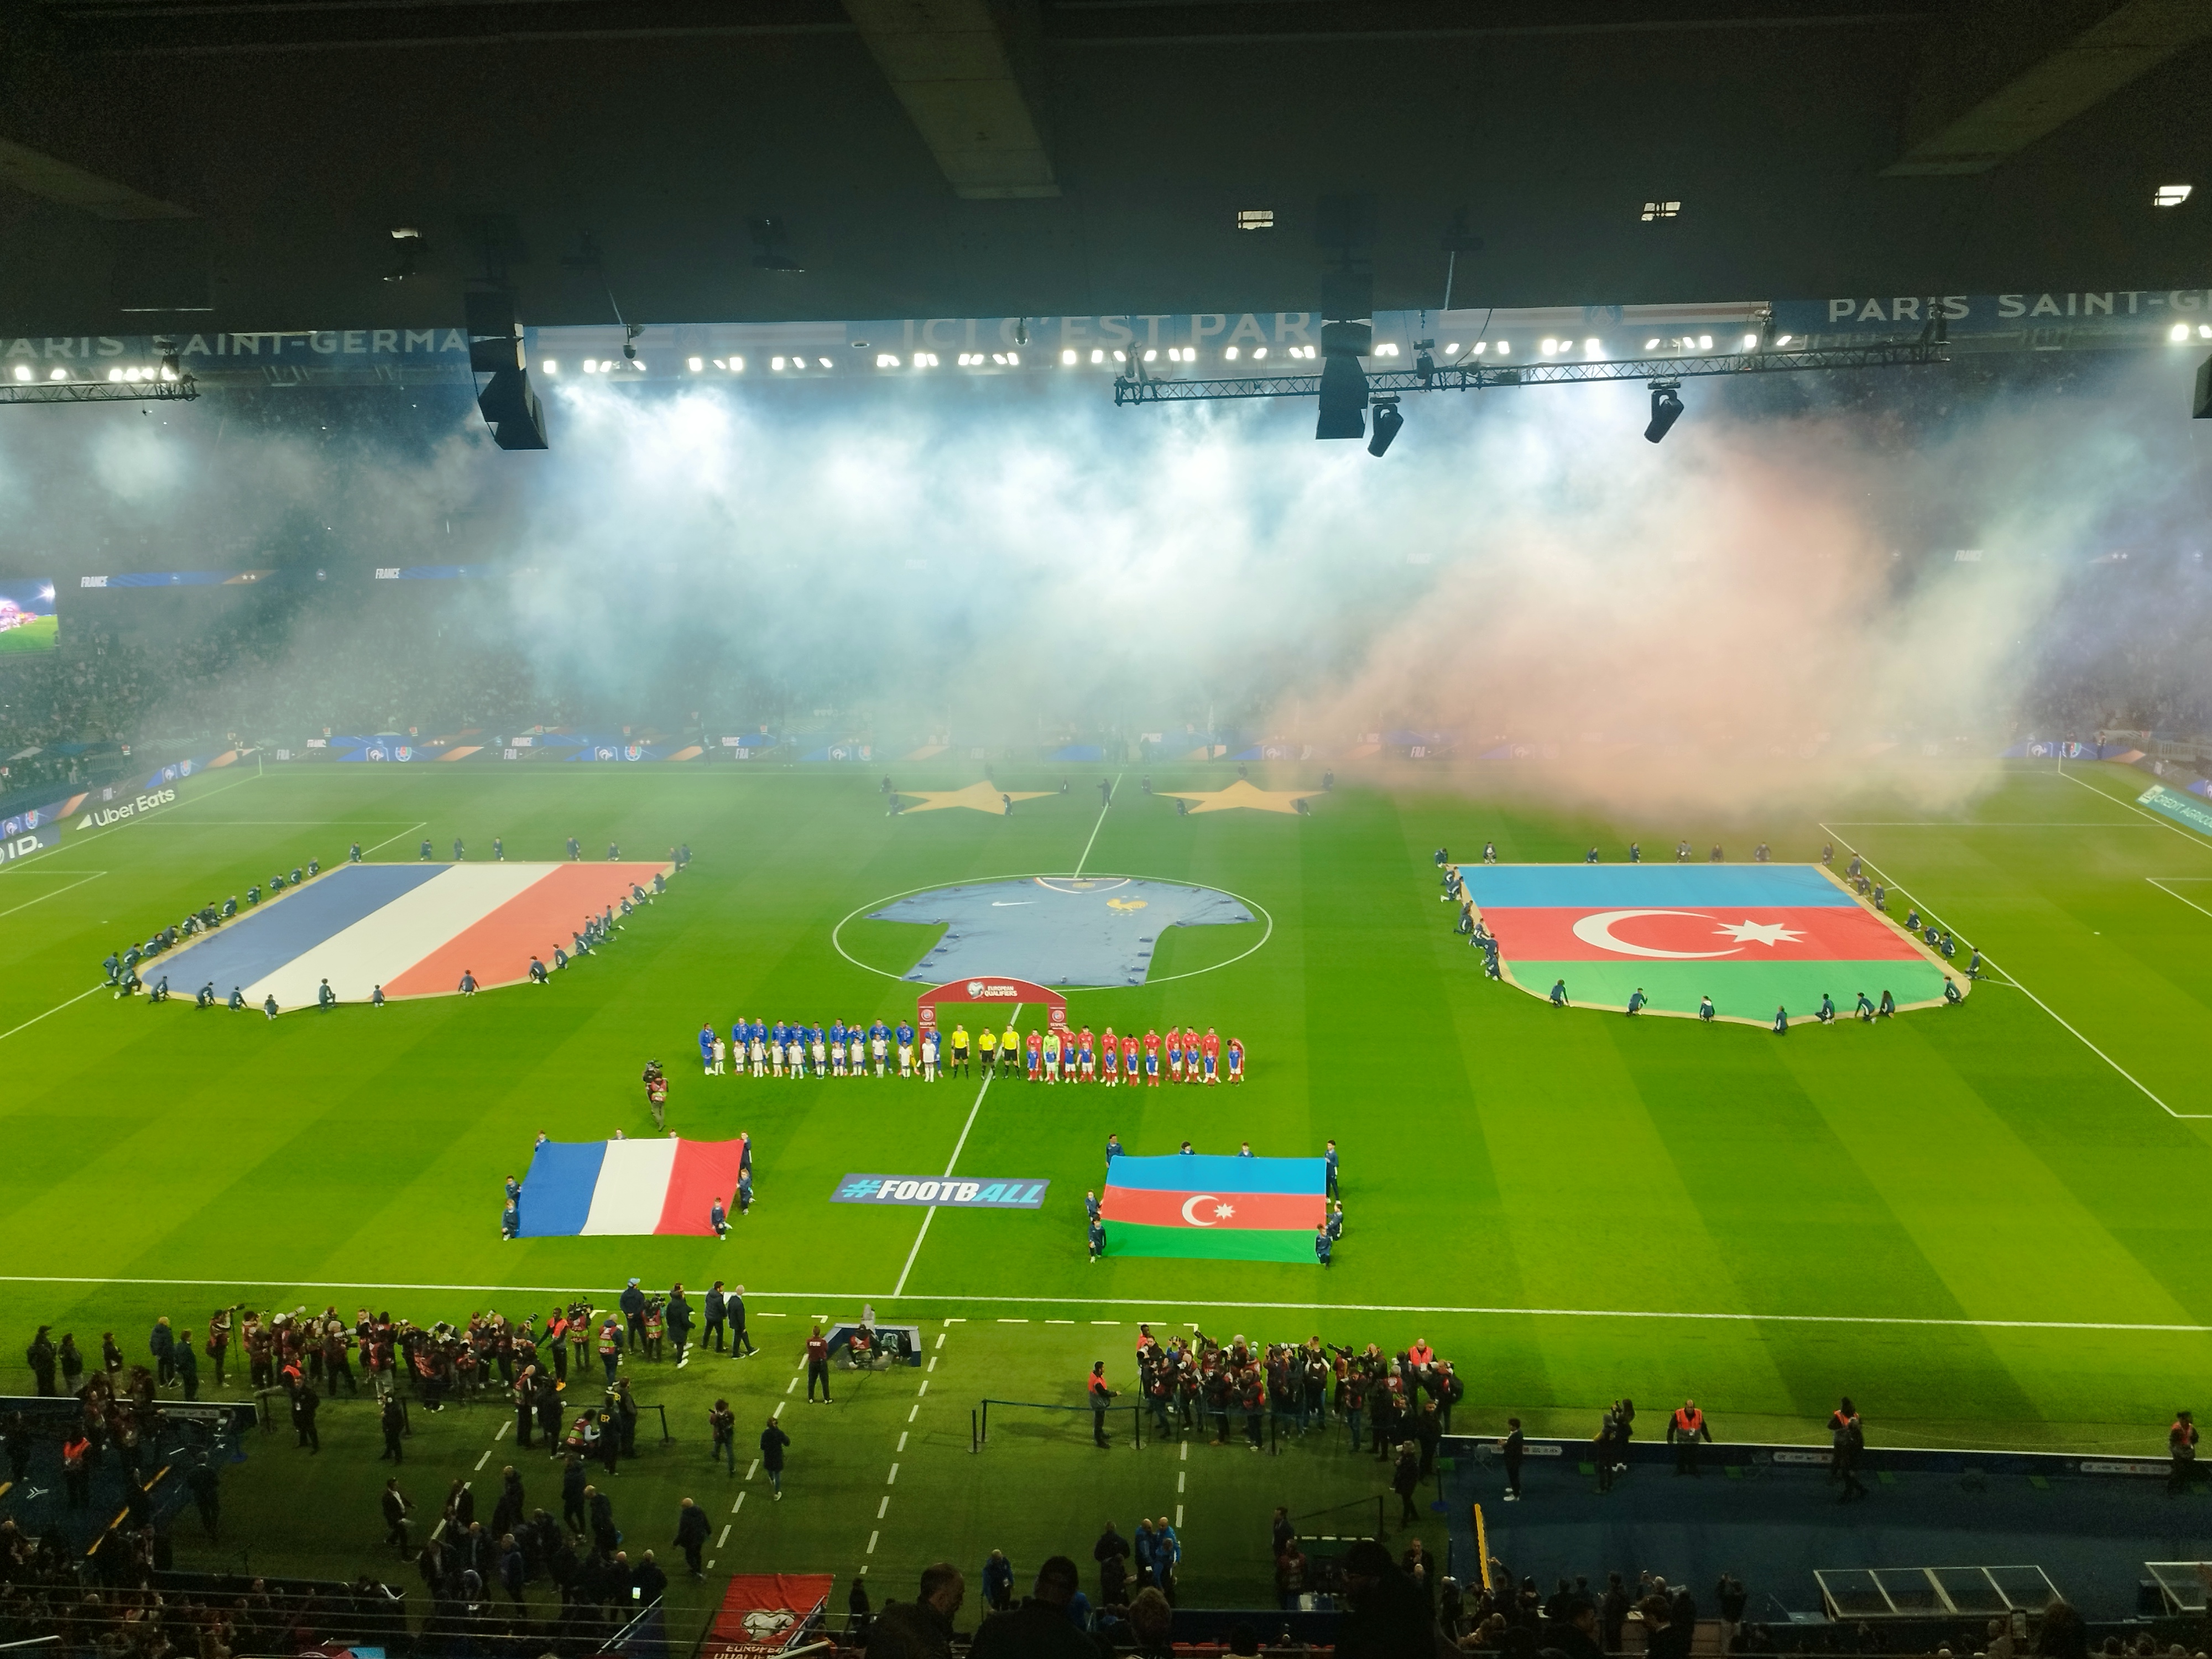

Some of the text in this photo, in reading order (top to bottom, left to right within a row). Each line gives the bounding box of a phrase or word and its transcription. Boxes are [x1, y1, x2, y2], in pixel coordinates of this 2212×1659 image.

[1829, 295, 1970, 322] PARS
[903, 319, 976, 349] ICI
[0, 336, 124, 358] ARIS
[81, 576, 108, 587] FRANCE
[375, 568, 400, 579] FRANCE
[94, 789, 175, 827] Uber Eats
[7, 835, 44, 859] ID.
[841, 1179, 1044, 1203] #FOOTBALL
